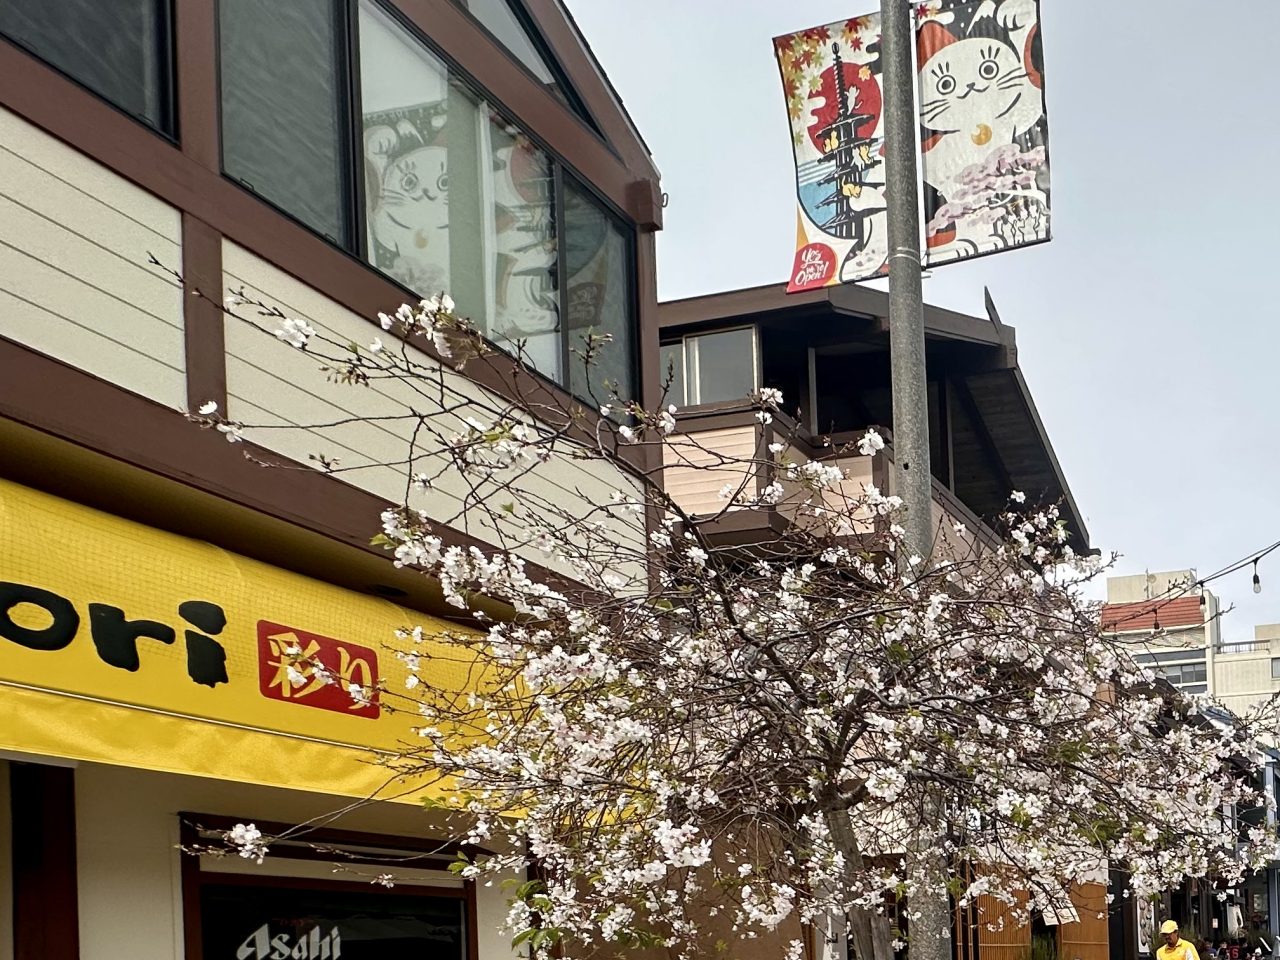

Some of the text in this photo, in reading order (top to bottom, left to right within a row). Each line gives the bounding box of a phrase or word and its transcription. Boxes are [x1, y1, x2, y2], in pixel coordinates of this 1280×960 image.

[801, 248, 823, 269] Yes
[0, 581, 229, 688] ori
[267, 631, 373, 709] 彩り
[236, 923, 341, 960] Asahi
